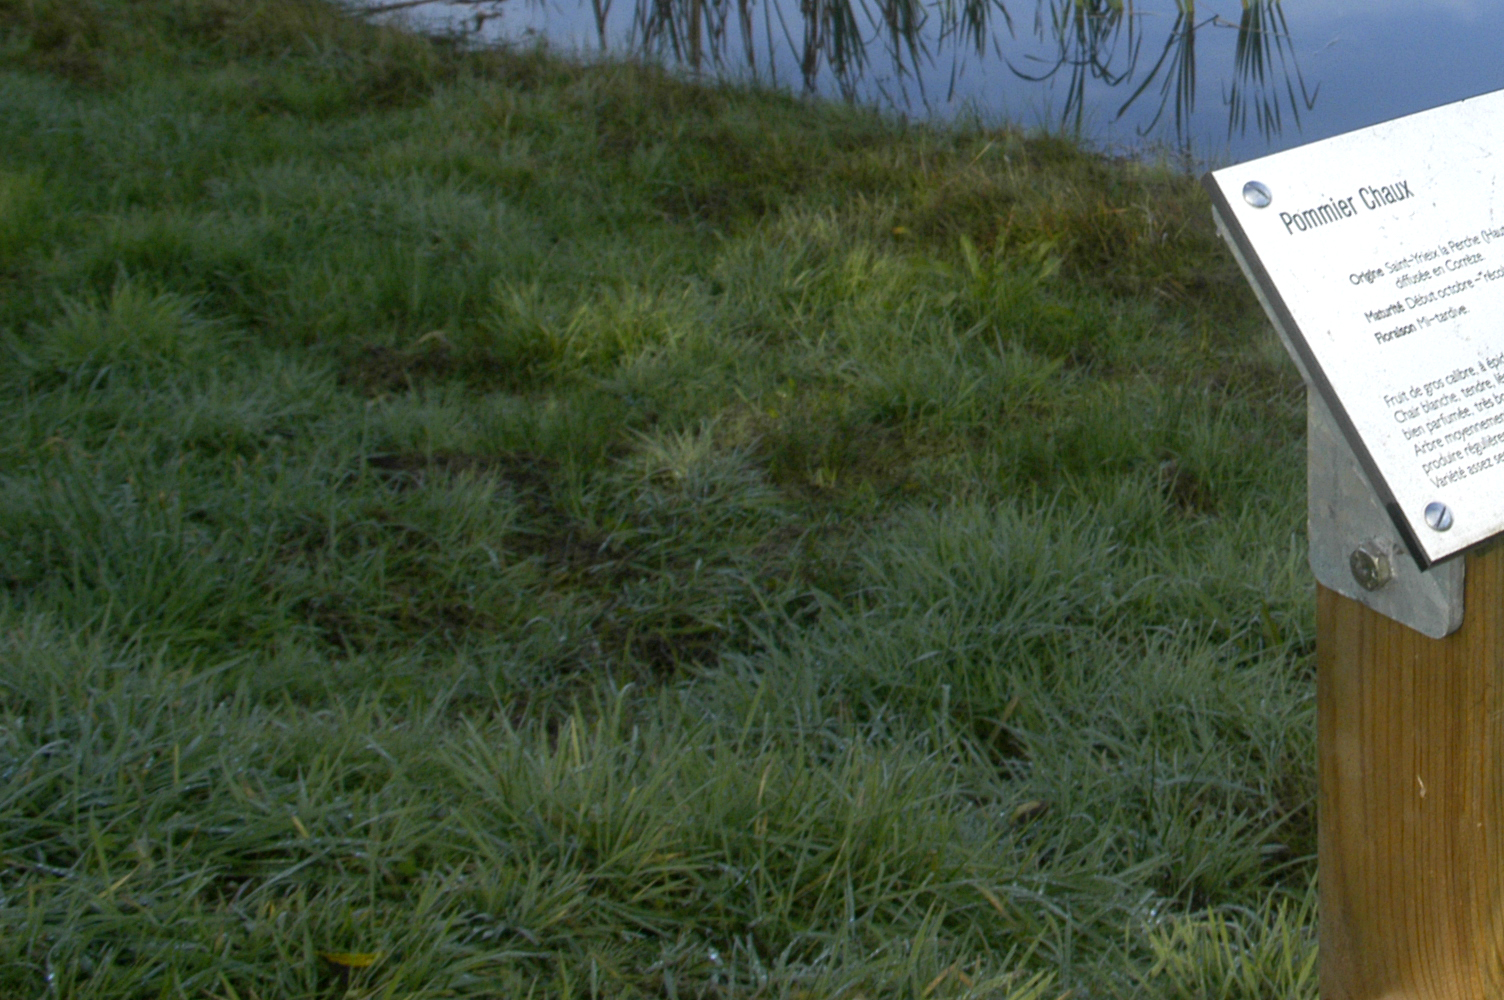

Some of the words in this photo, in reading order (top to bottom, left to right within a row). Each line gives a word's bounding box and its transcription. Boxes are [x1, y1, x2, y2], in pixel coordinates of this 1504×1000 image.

[1278, 196, 1358, 236] Pommier
[1357, 179, 1415, 211] Chaux
[1348, 267, 1385, 286] Origine
[1437, 244, 1450, 256] la
[1447, 235, 1482, 253] Perche
[1395, 269, 1433, 290] diffusée
[1431, 265, 1446, 277] en
[1363, 300, 1406, 324] Maturité
[1404, 291, 1439, 310] Début
[1436, 279, 1475, 299] octobre
[1373, 323, 1418, 345] Floraison
[1383, 391, 1410, 408] Fruit
[1409, 385, 1424, 399] de
[1423, 378, 1445, 397] gros
[1477, 360, 1487, 373] à
[1393, 407, 1420, 424] Chair
[1419, 392, 1462, 414] blanche,
[1460, 379, 1497, 398] tendre,
[1401, 425, 1426, 441] bien
[1473, 397, 1495, 413] très
[1413, 438, 1445, 457] Arbre
[1421, 450, 1464, 477] produire
[1429, 466, 1468, 489] Variété
[1466, 457, 1494, 476] assez
